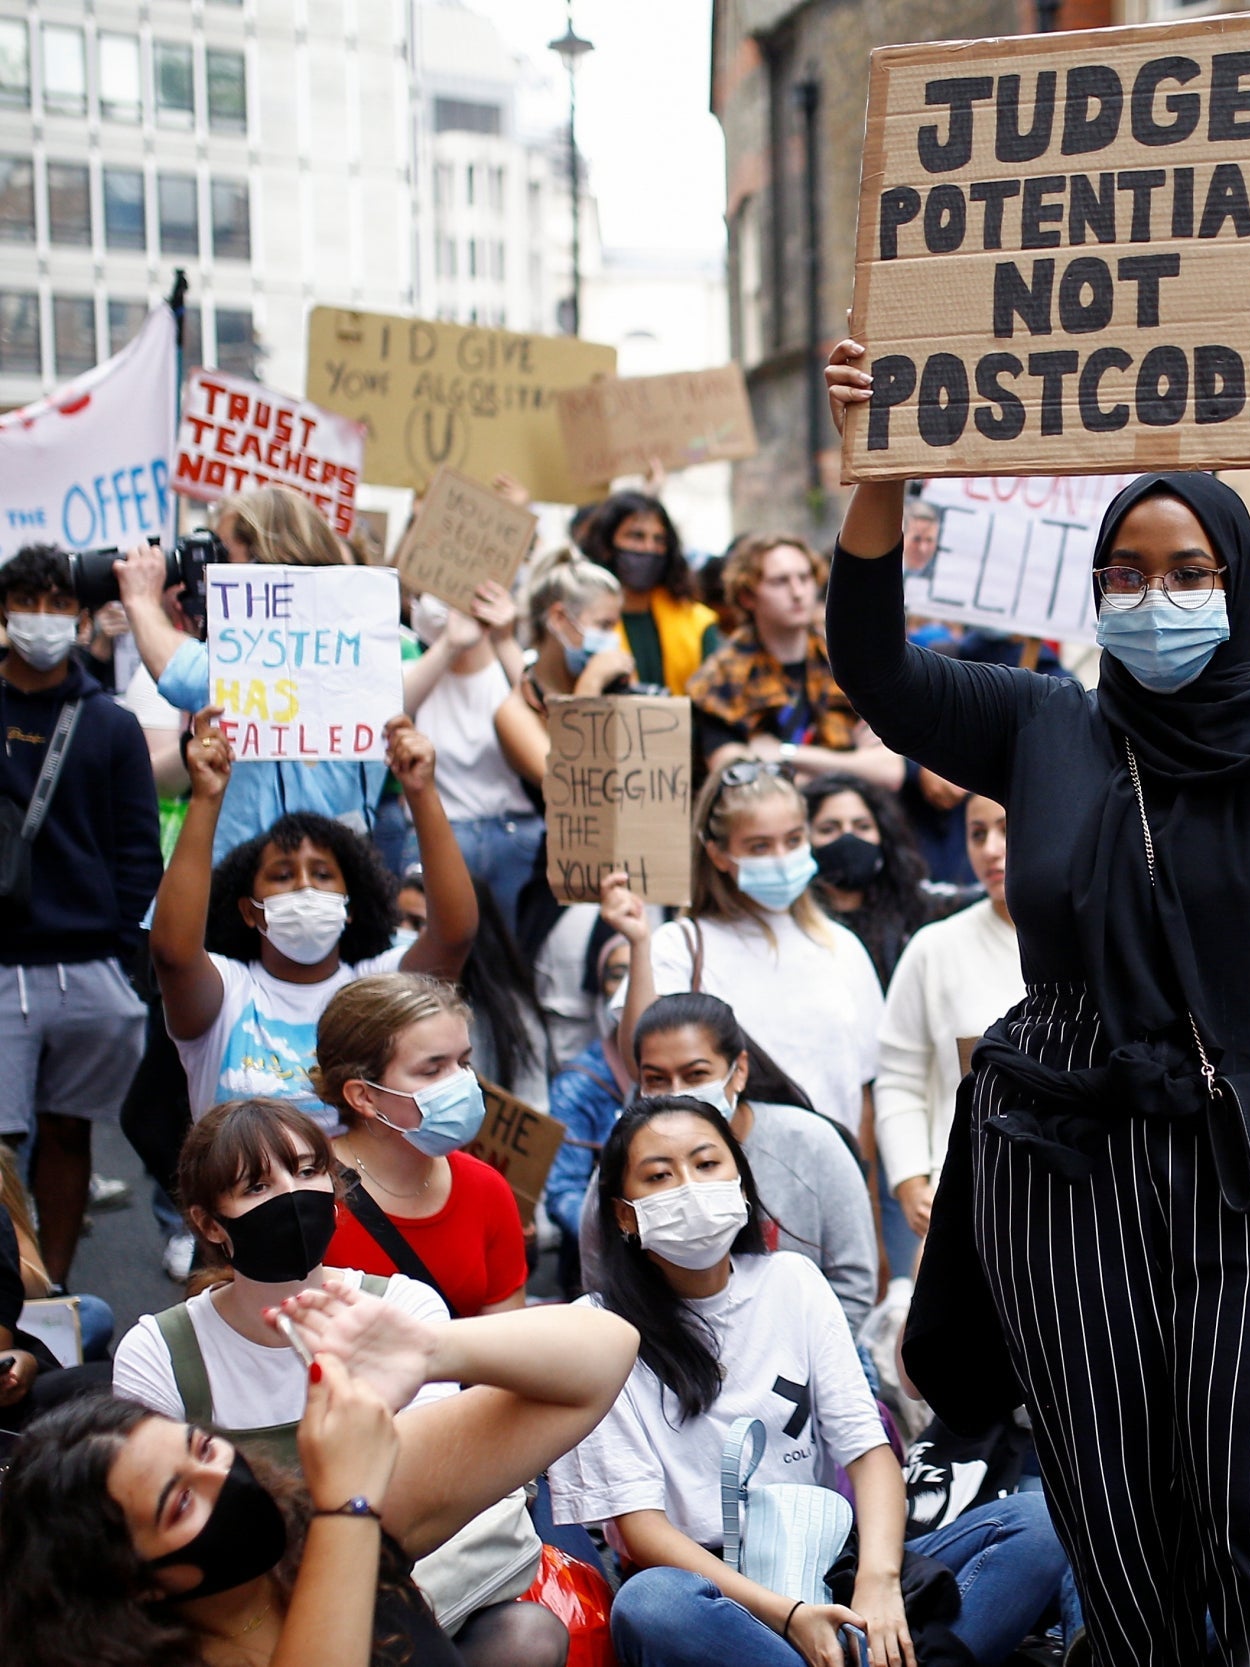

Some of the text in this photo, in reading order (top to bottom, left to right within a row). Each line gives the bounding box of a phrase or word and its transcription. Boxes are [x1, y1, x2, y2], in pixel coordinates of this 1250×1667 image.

[992, 252, 1181, 339] NOT
[457, 331, 535, 373] GIVE
[199, 381, 316, 448] TRUST
[177, 453, 249, 492] NOT
[186, 416, 357, 498] TEACHERS
[6, 457, 170, 548] THE OFFER
[210, 582, 294, 620] THE
[216, 628, 361, 668] SYSTEM
[215, 677, 299, 723] HAS
[219, 720, 374, 757] FAILED
[559, 706, 680, 763] STOP
[551, 761, 688, 815] SHEGGING
[554, 812, 601, 851] THE
